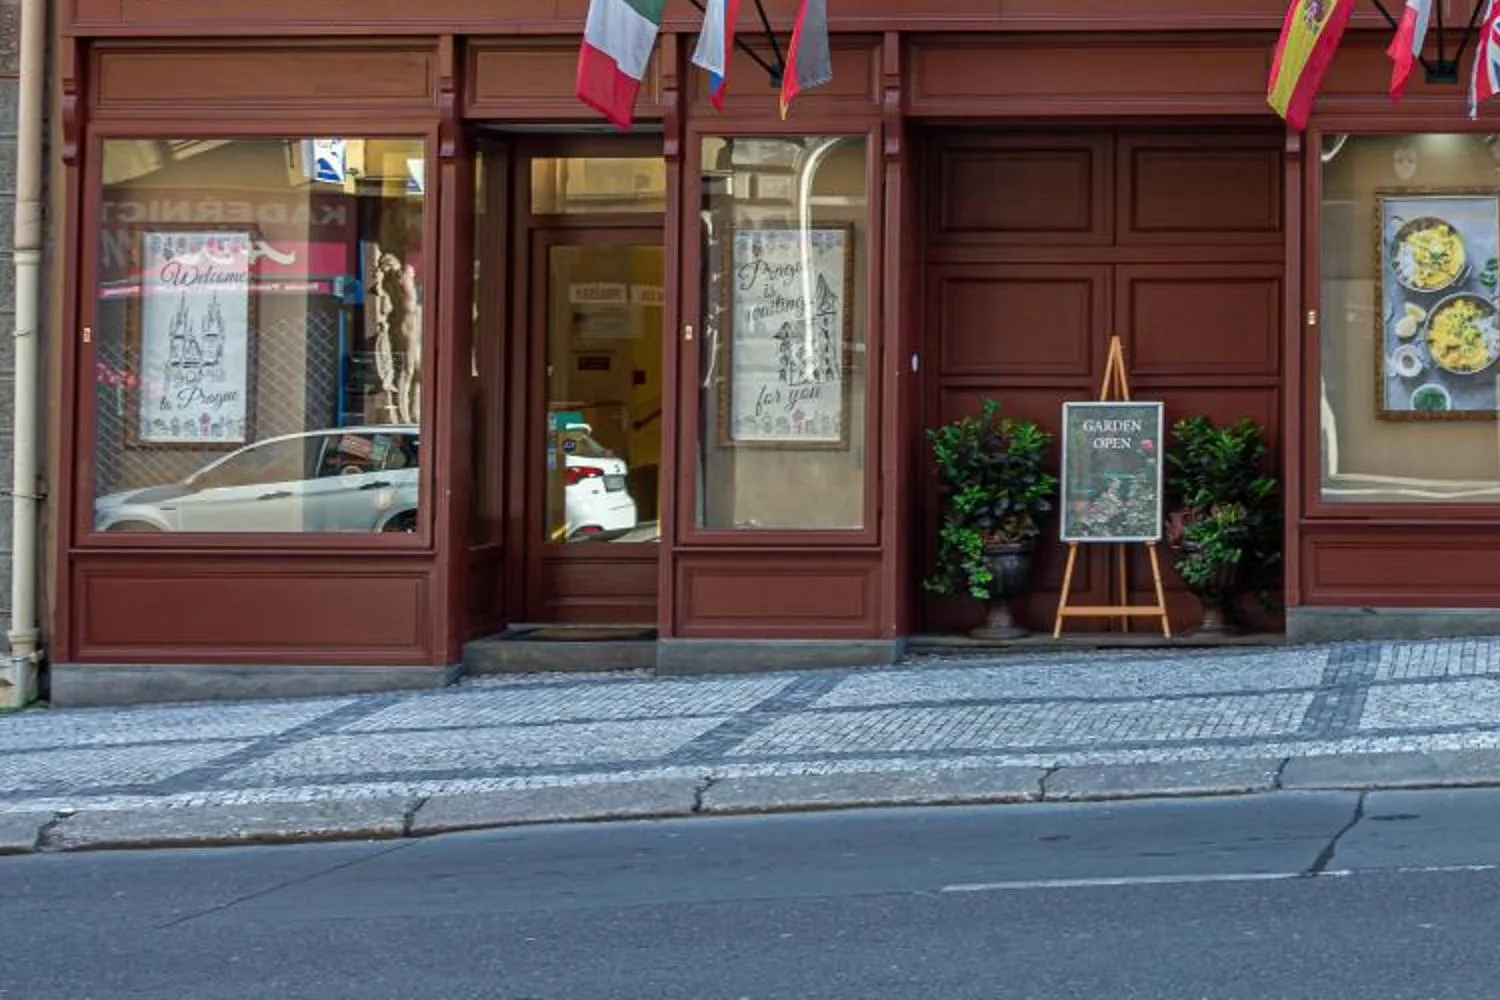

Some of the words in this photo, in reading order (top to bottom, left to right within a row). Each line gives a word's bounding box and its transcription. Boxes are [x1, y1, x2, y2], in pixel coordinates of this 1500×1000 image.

[160, 260, 248, 286] Welcome
[738, 259, 808, 291] Prag
[177, 387, 238, 410] Prague
[1083, 419, 1142, 432] GARDEN
[1092, 437, 1132, 449] OPEN
